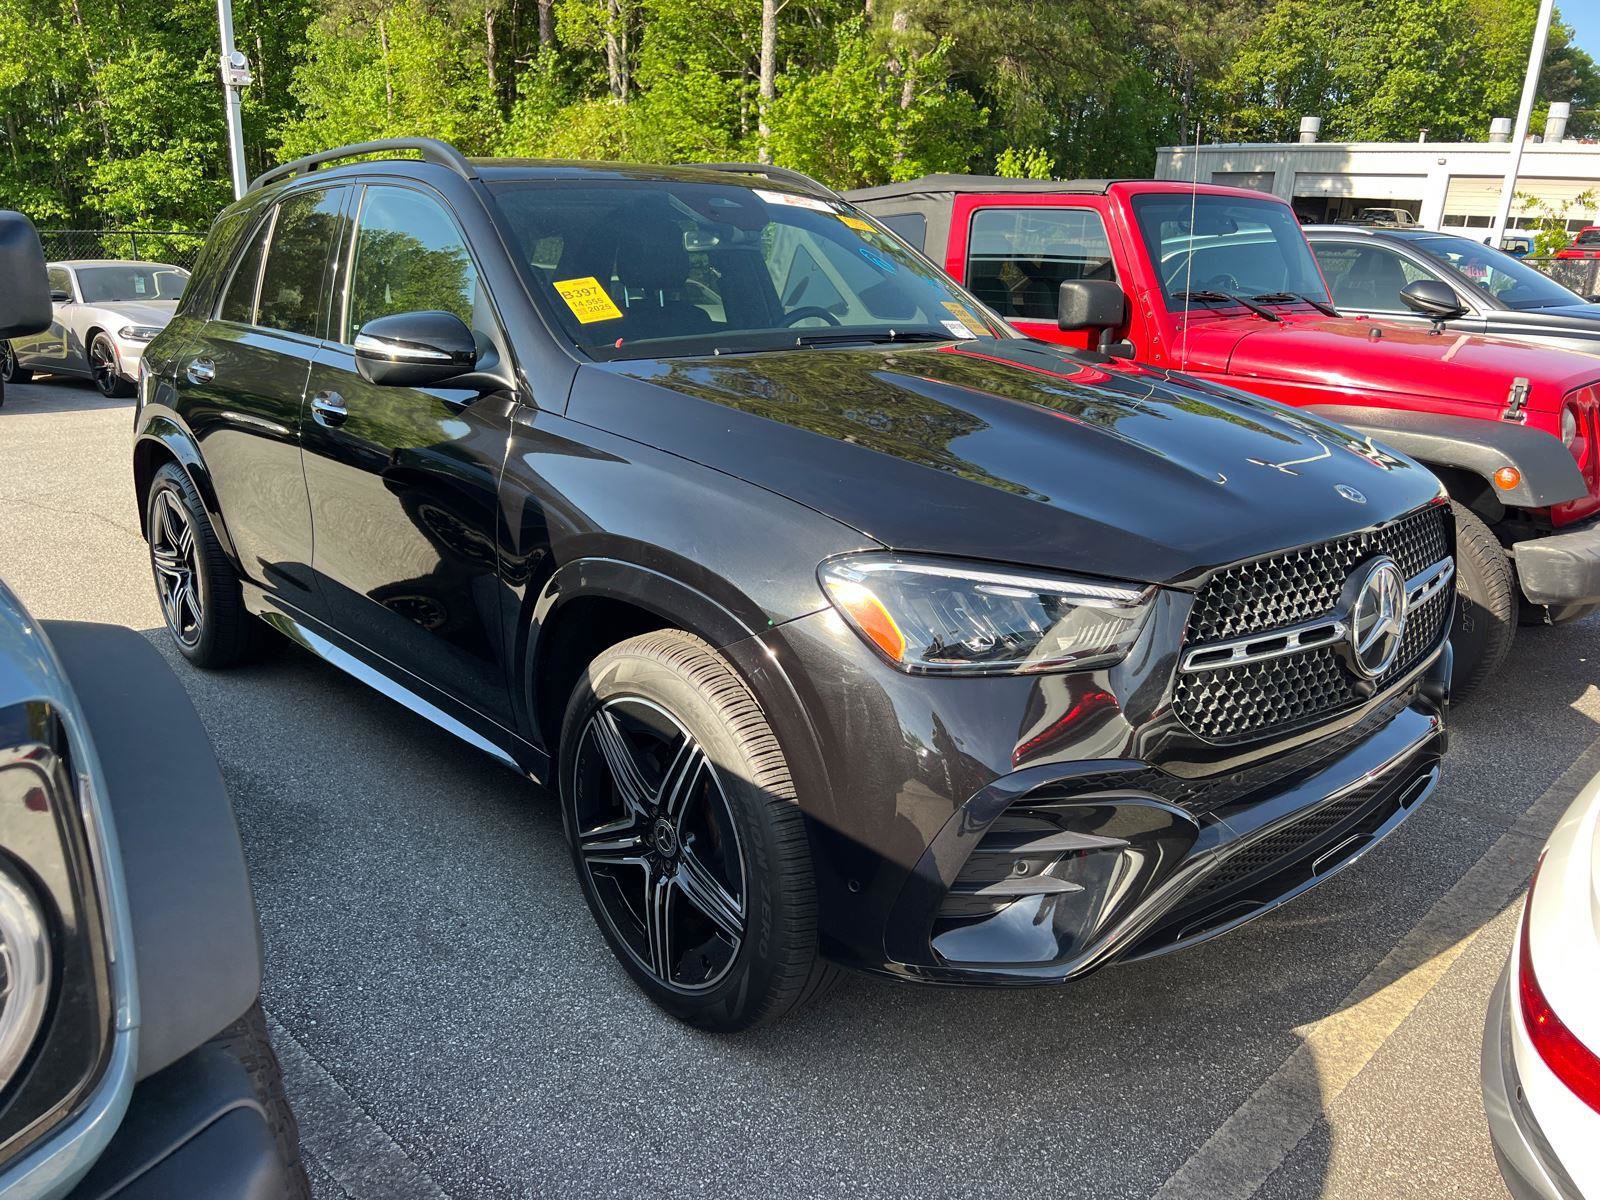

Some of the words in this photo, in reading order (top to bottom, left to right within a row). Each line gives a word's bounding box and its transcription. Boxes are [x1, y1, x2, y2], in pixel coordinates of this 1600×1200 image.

[561, 286, 598, 300] B397
[587, 303, 612, 312] 2025
[759, 879, 773, 958] ZERO
